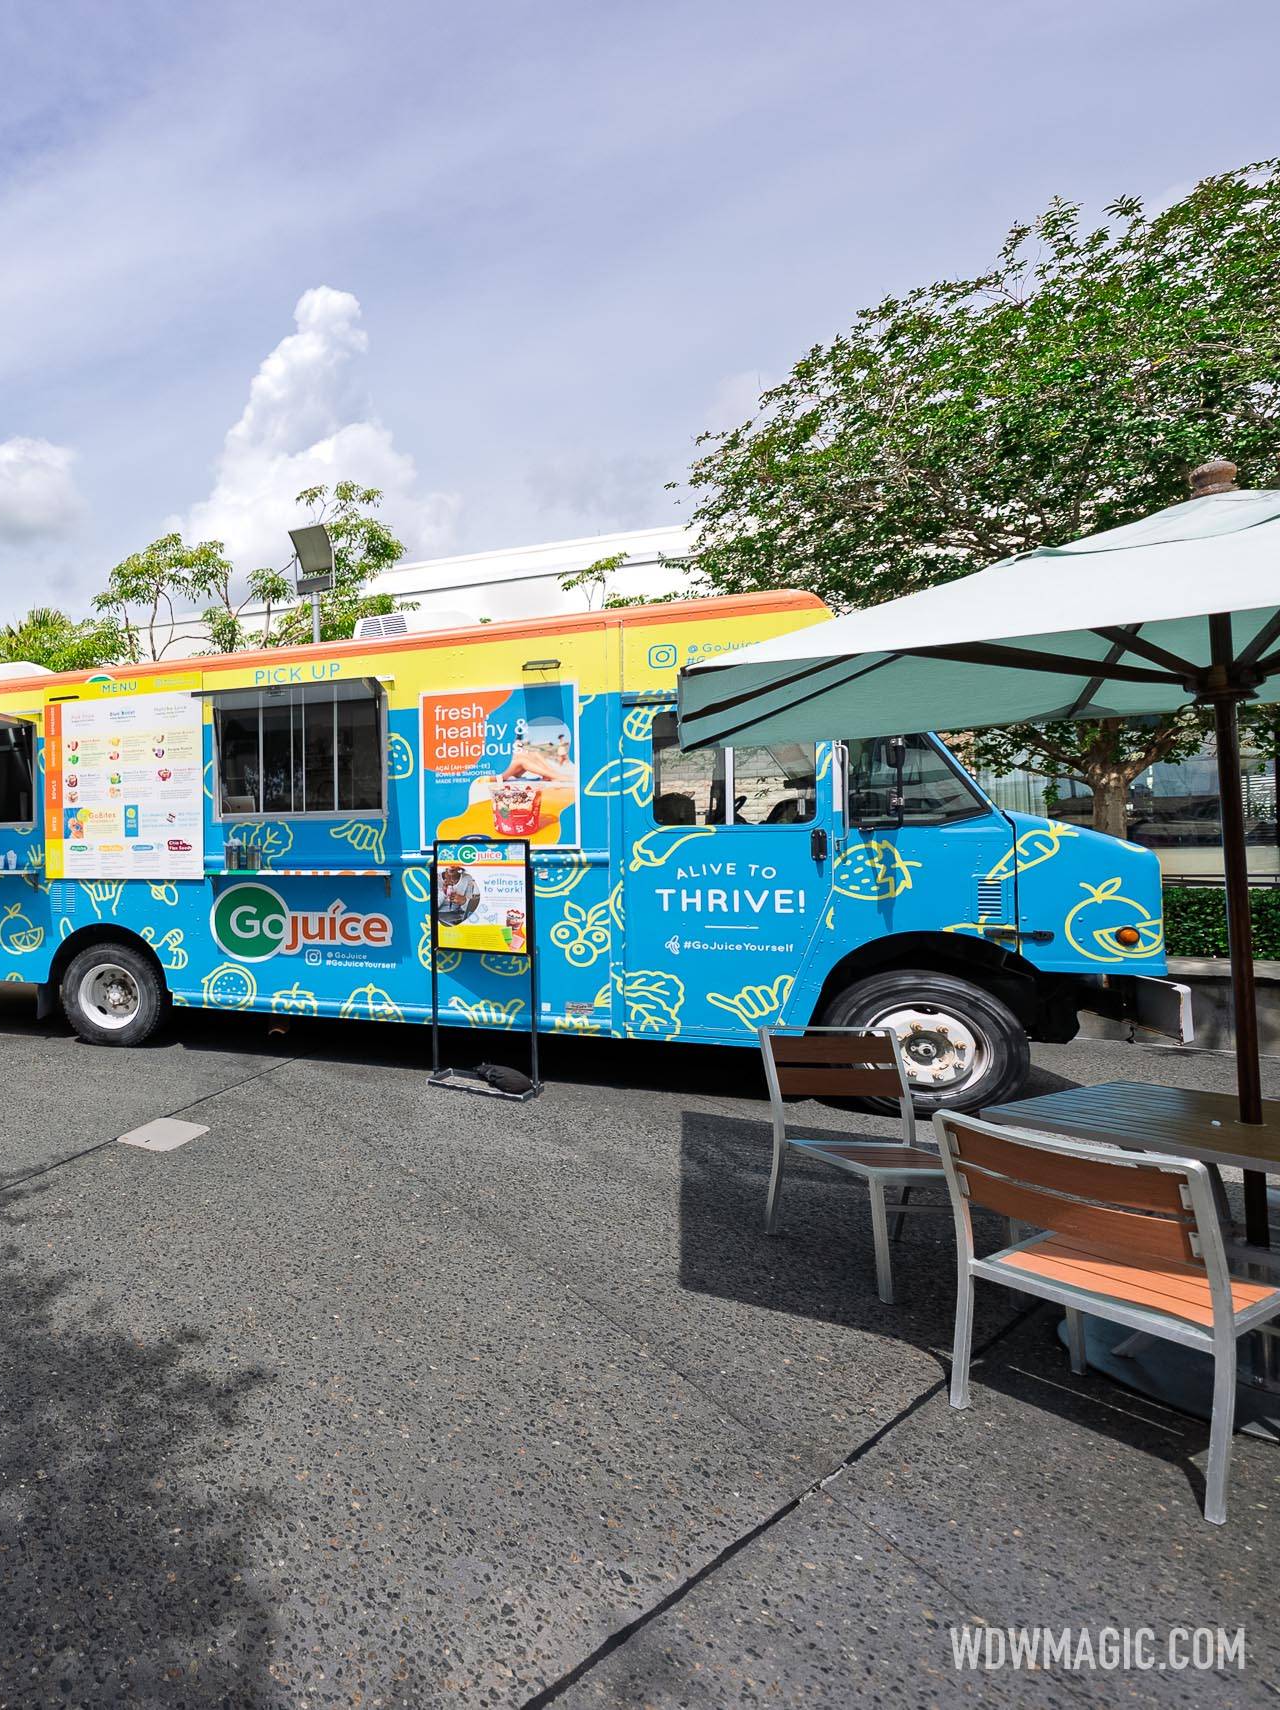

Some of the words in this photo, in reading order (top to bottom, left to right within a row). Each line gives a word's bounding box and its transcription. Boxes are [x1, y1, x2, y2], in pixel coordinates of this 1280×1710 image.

[255, 666, 302, 685] PICK
[312, 663, 341, 680] UP
[102, 681, 137, 693] MENU
[435, 703, 490, 721] fresh,
[435, 721, 508, 740] healthy
[515, 718, 529, 735] &
[435, 740, 529, 758] delicious.
[676, 863, 737, 880] ALIVE
[749, 864, 777, 879] TO
[655, 889, 805, 913] THRIVE!
[683, 941, 794, 953] #GoJuiceYourself
